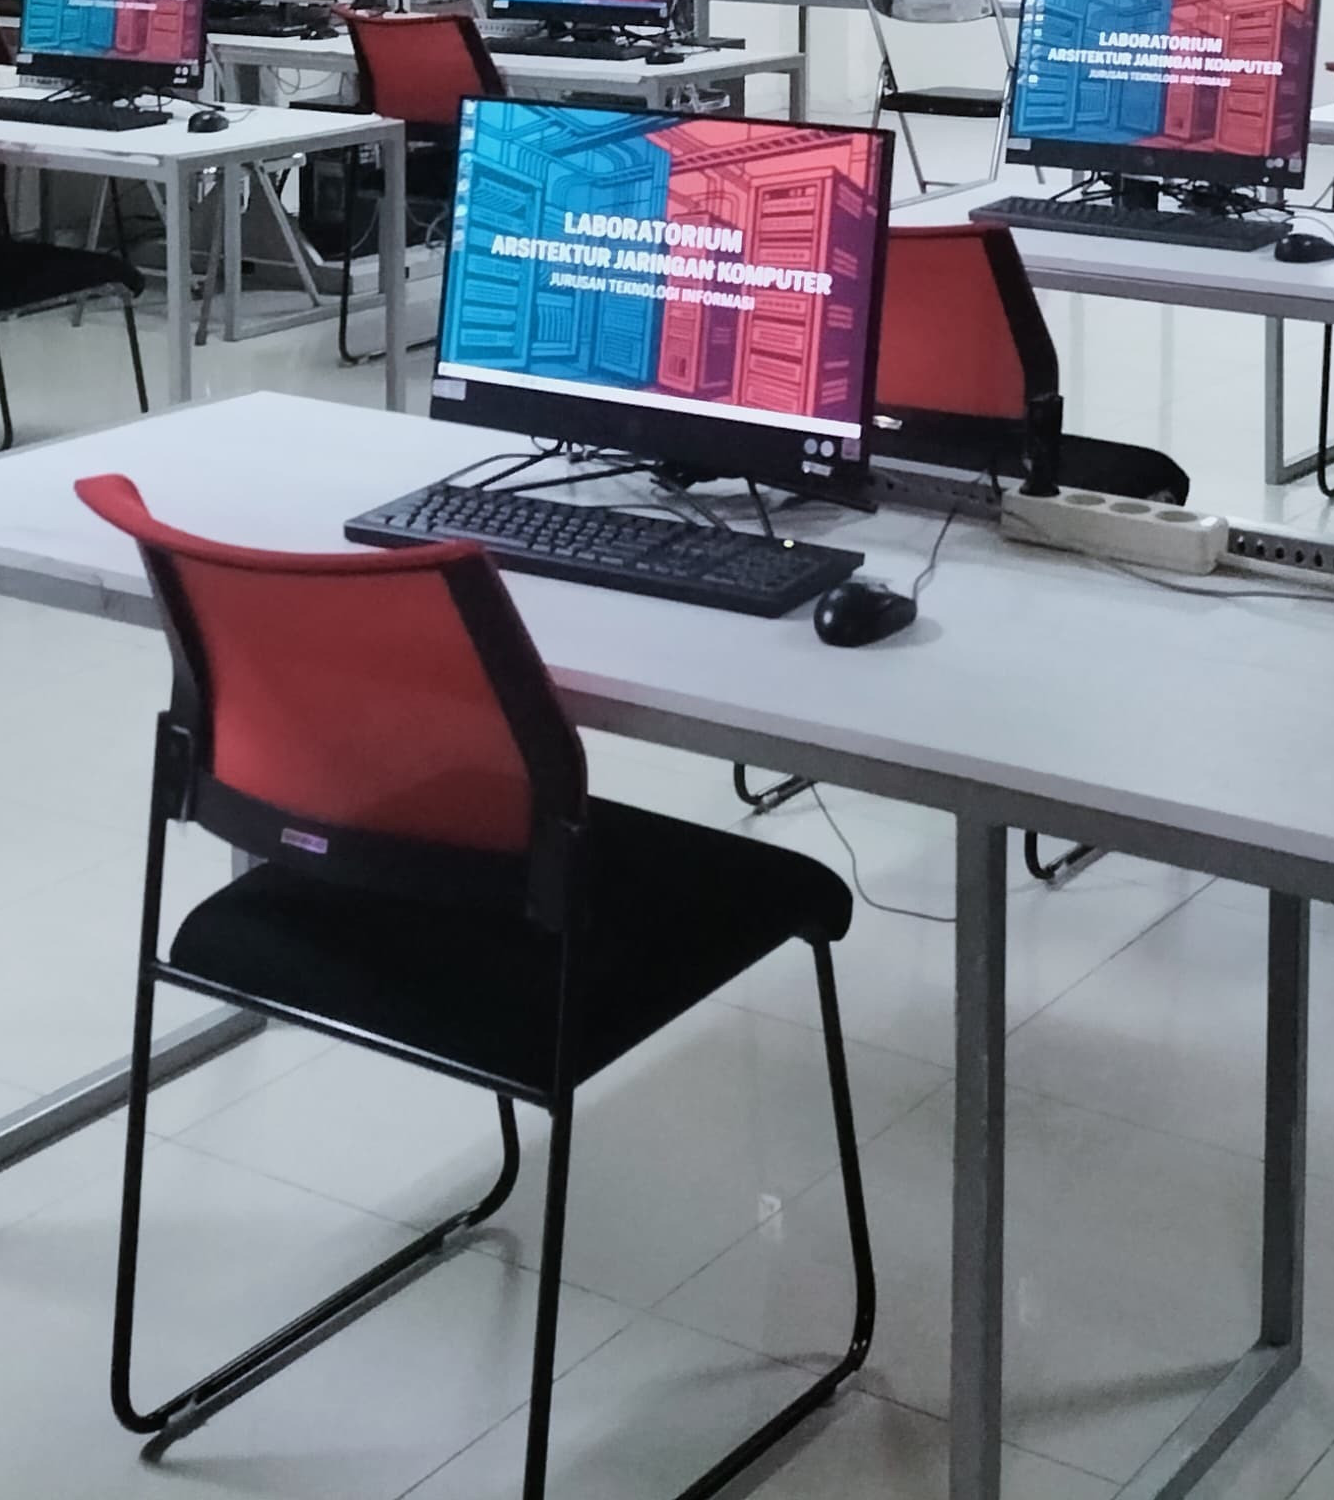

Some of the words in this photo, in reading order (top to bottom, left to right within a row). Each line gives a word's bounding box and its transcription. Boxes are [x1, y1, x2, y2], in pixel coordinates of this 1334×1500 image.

[1099, 31, 1222, 53] LABORATORIUM
[1048, 48, 1131, 66] ARSITEKTUR
[1133, 53, 1203, 71] JARINGAN
[1205, 58, 1283, 76] KOMPUTER
[564, 212, 743, 253] LABORATORIUM
[491, 235, 611, 268] ARSITEKTUR
[613, 251, 716, 280] JARINGAN
[717, 262, 832, 295] KOMPUTER
[550, 272, 606, 291] JURUSAN
[609, 277, 679, 300] TEKNOLOGI
[681, 288, 755, 311] INFORMASI
